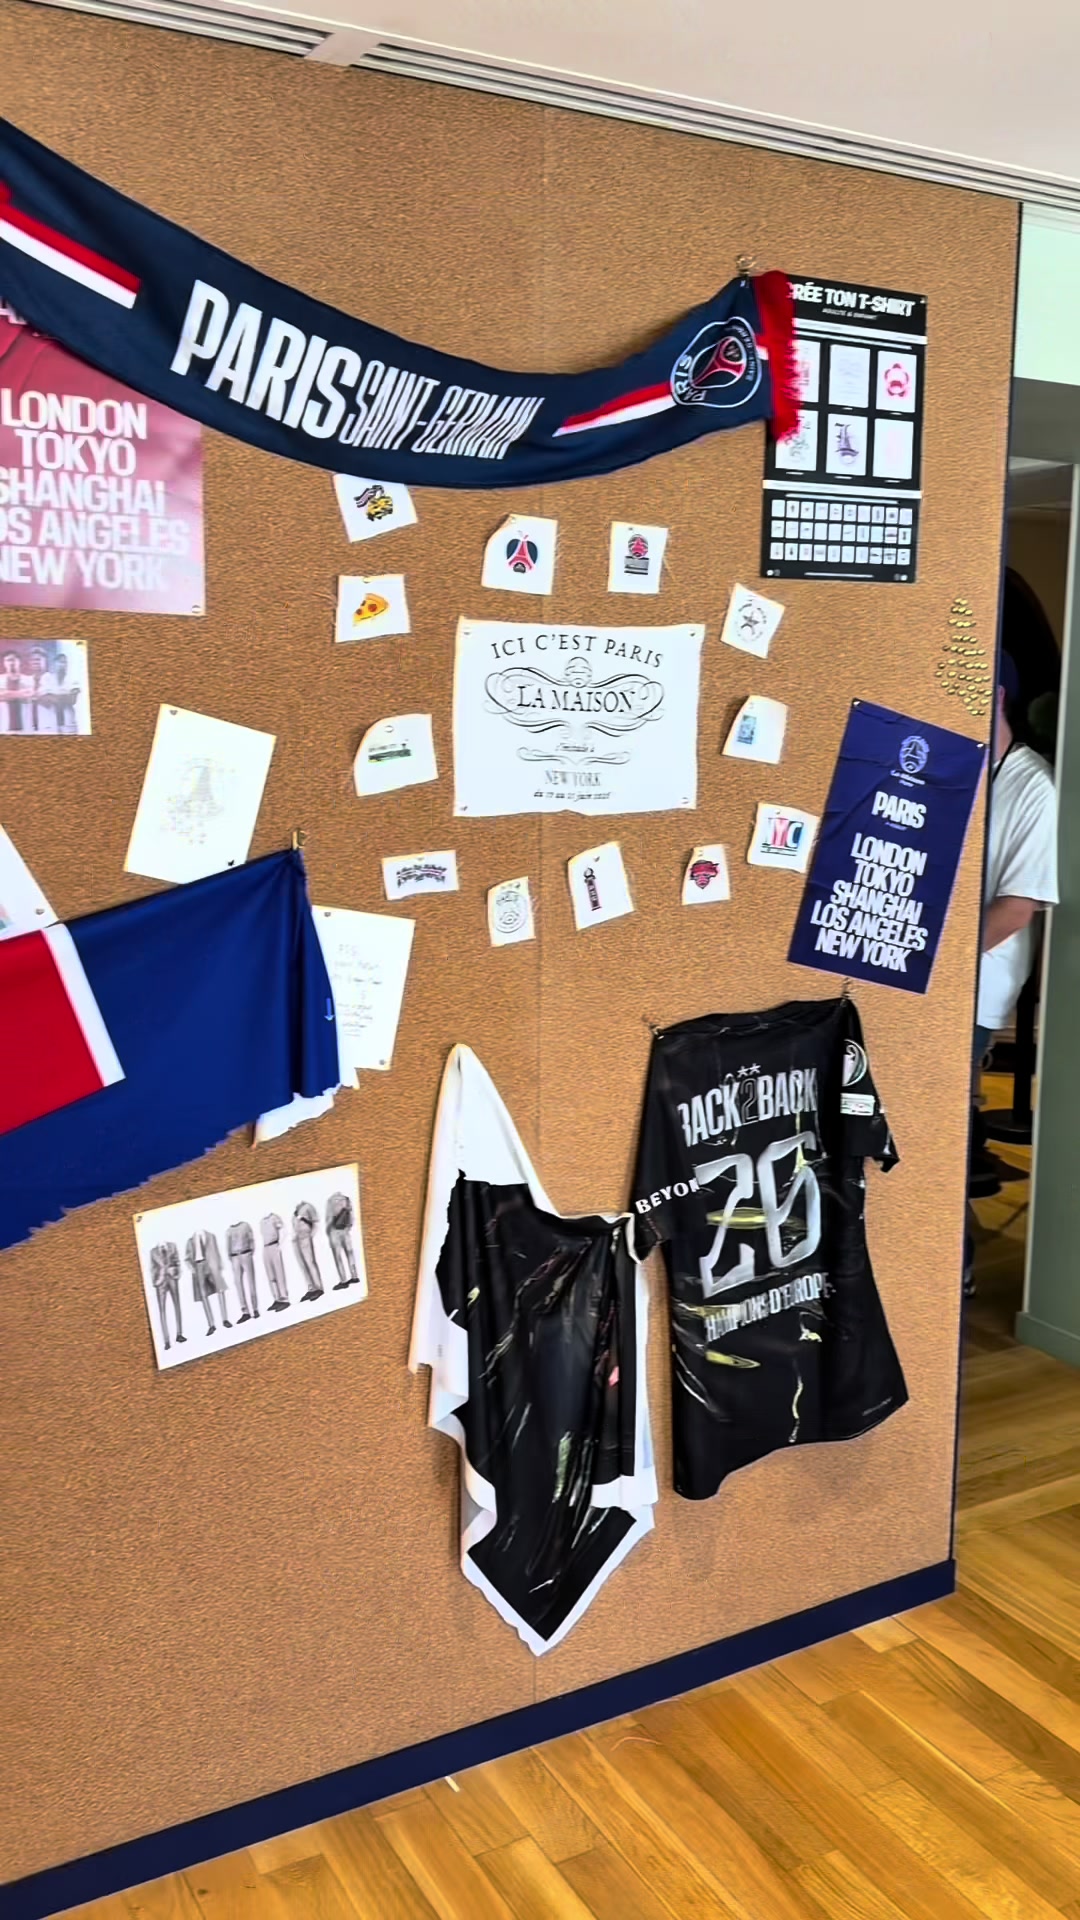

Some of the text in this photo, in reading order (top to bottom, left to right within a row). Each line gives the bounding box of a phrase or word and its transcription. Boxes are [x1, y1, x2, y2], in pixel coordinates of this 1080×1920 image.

[824, 288, 857, 308] TON
[858, 293, 916, 317] T-SHIRT
[170, 279, 545, 460] PARIS SAINT-GERMAIN
[0, 387, 147, 439] LONDON
[15, 429, 136, 476] TOKYO
[38, 510, 191, 555] ANGELES
[74, 550, 169, 591] YORK
[491, 633, 664, 668] ICI C'EST PARIS
[516, 684, 637, 713] LA MAISON
[871, 790, 927, 829] PARIS
[850, 832, 928, 877] LONDON
[854, 859, 915, 897] TOKYO
[830, 879, 924, 925] SHANGHAI
[810, 899, 929, 952] LOS ANGELES
[815, 927, 908, 973] NEW YORK
[635, 1177, 700, 1215] BEYON
